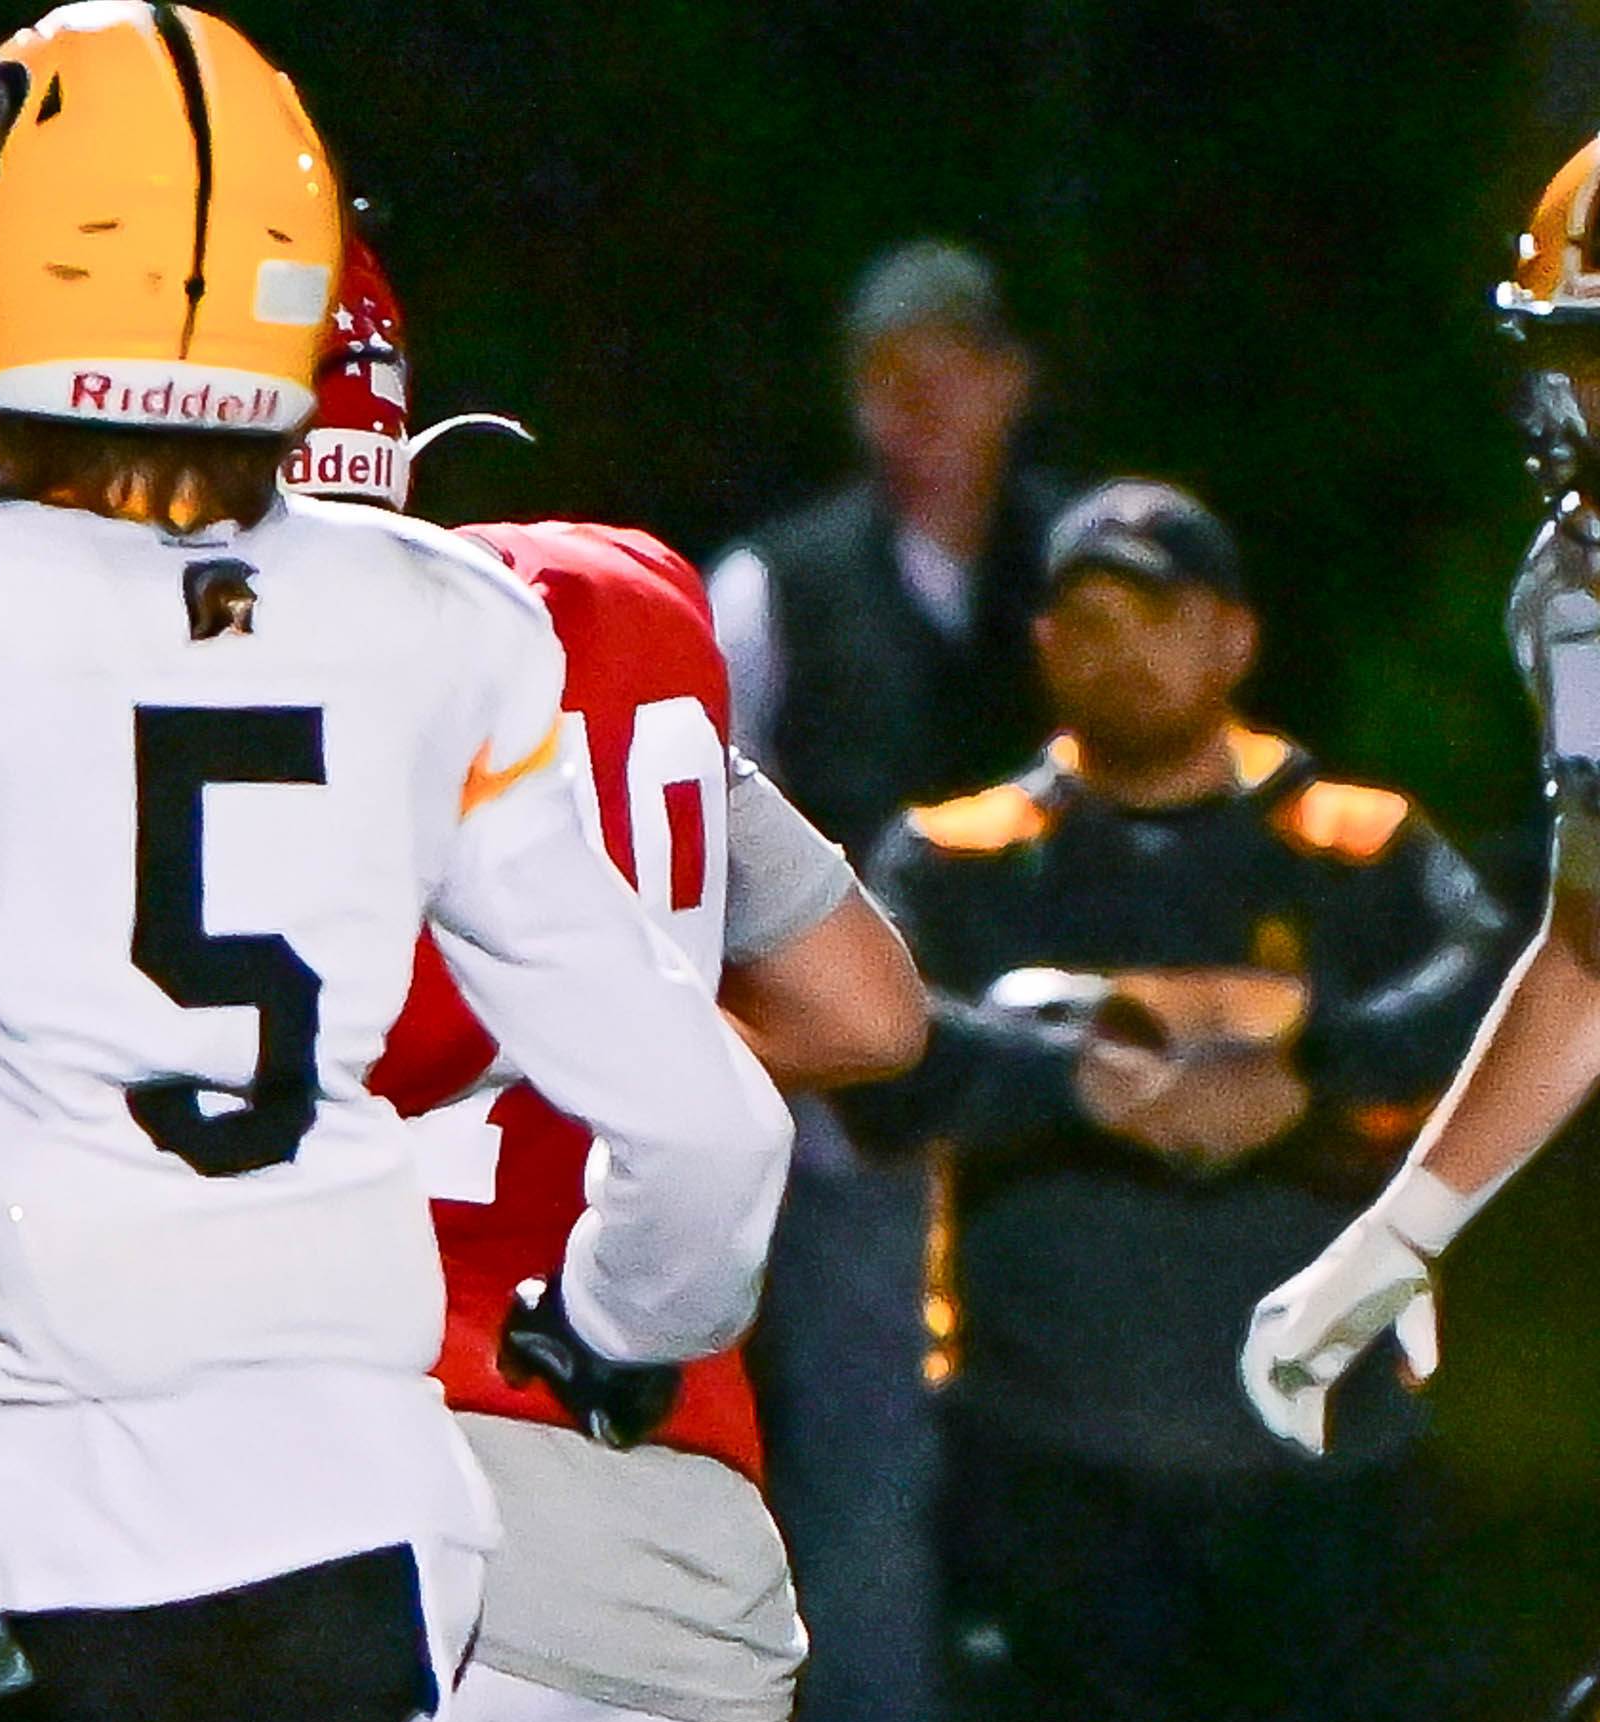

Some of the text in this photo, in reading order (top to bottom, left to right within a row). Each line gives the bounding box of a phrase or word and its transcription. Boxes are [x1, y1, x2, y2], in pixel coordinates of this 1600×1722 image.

[70, 371, 281, 423] Riddell
[284, 443, 394, 488] ddell
[124, 703, 328, 1177] 5
